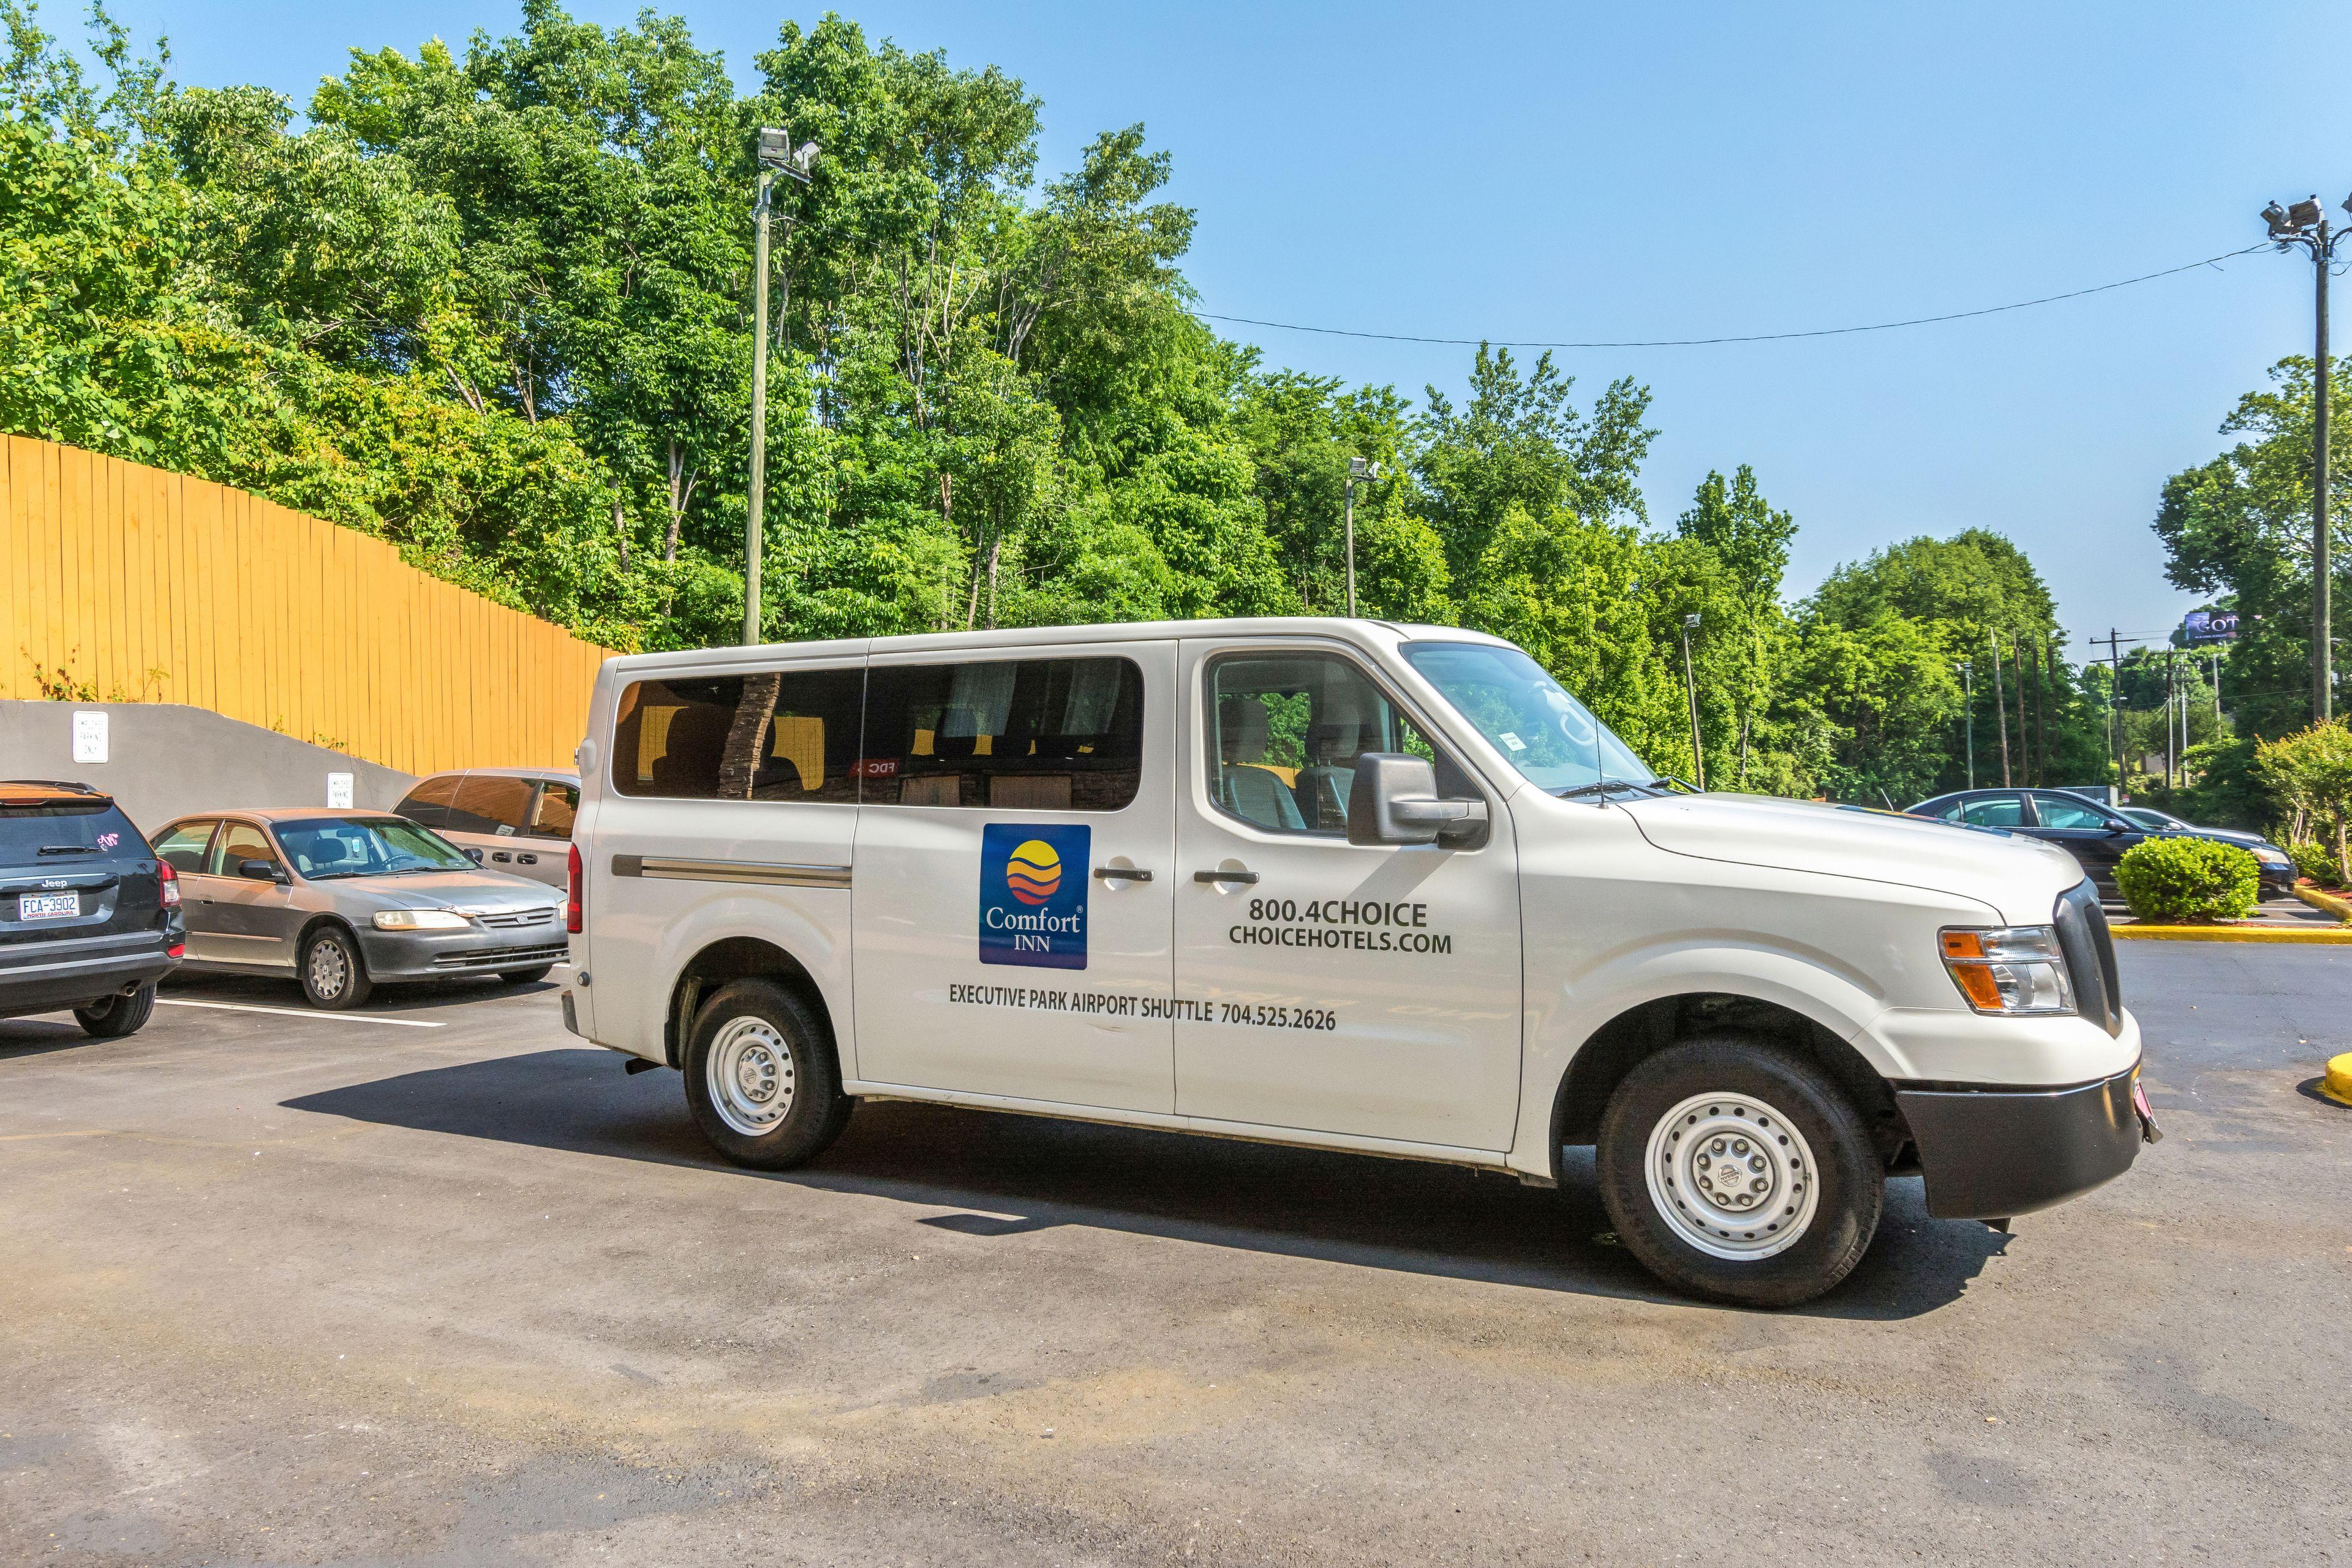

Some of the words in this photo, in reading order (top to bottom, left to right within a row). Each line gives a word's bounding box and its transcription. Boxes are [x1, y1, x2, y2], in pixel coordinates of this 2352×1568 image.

[42, 880, 67, 889] Jeep
[23, 897, 76, 914] FCA-3902
[1249, 899, 1428, 927] 800.4CHOICE
[1014, 934, 1051, 952] INN
[1229, 925, 1452, 954] CHOICEHOTELS.COM
[949, 984, 1026, 1008] EXECUTIVE
[1029, 989, 1068, 1011] PARK
[1071, 992, 1138, 1016] AIRPORT
[1141, 997, 1213, 1022] SHUTTLE
[1221, 1003, 1336, 1031] 704.525.2626
